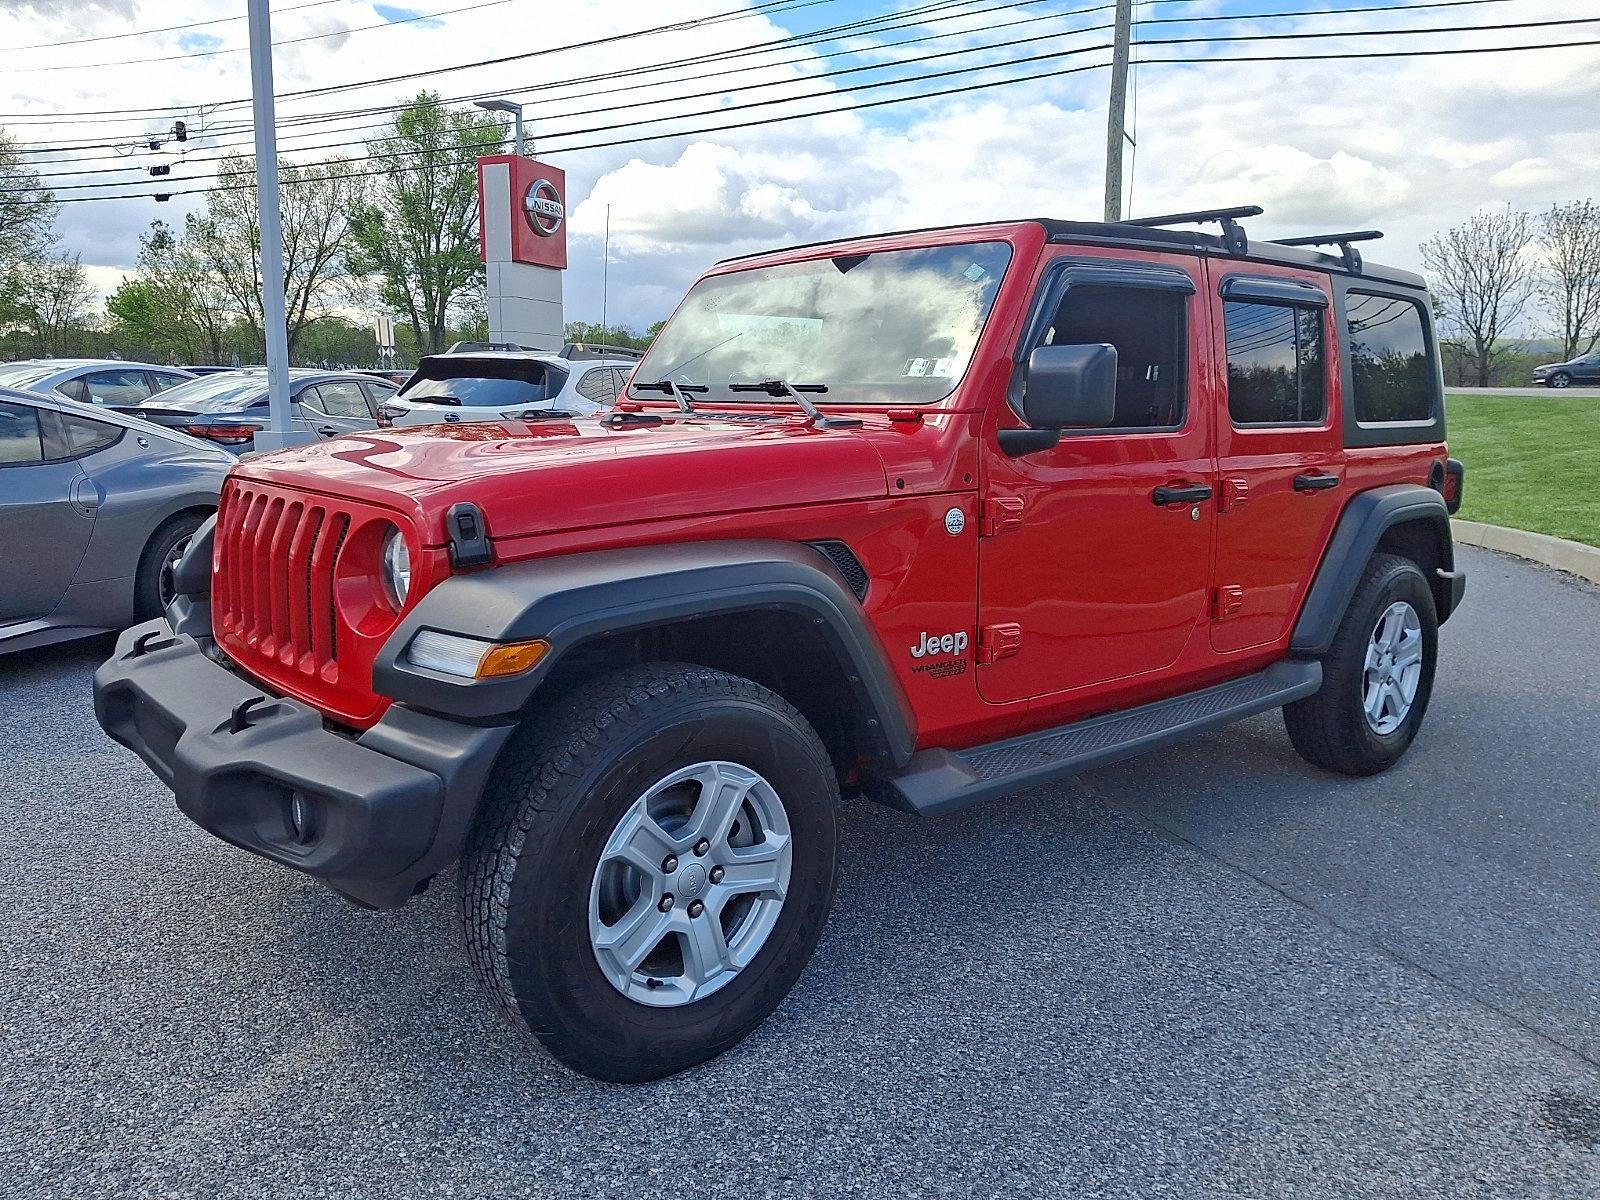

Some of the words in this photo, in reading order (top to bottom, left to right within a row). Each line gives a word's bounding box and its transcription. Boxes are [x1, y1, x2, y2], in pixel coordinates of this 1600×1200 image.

[534, 200, 563, 215] NISSAN
[910, 631, 968, 658] Jeep
[911, 658, 967, 674] WRANGLER
